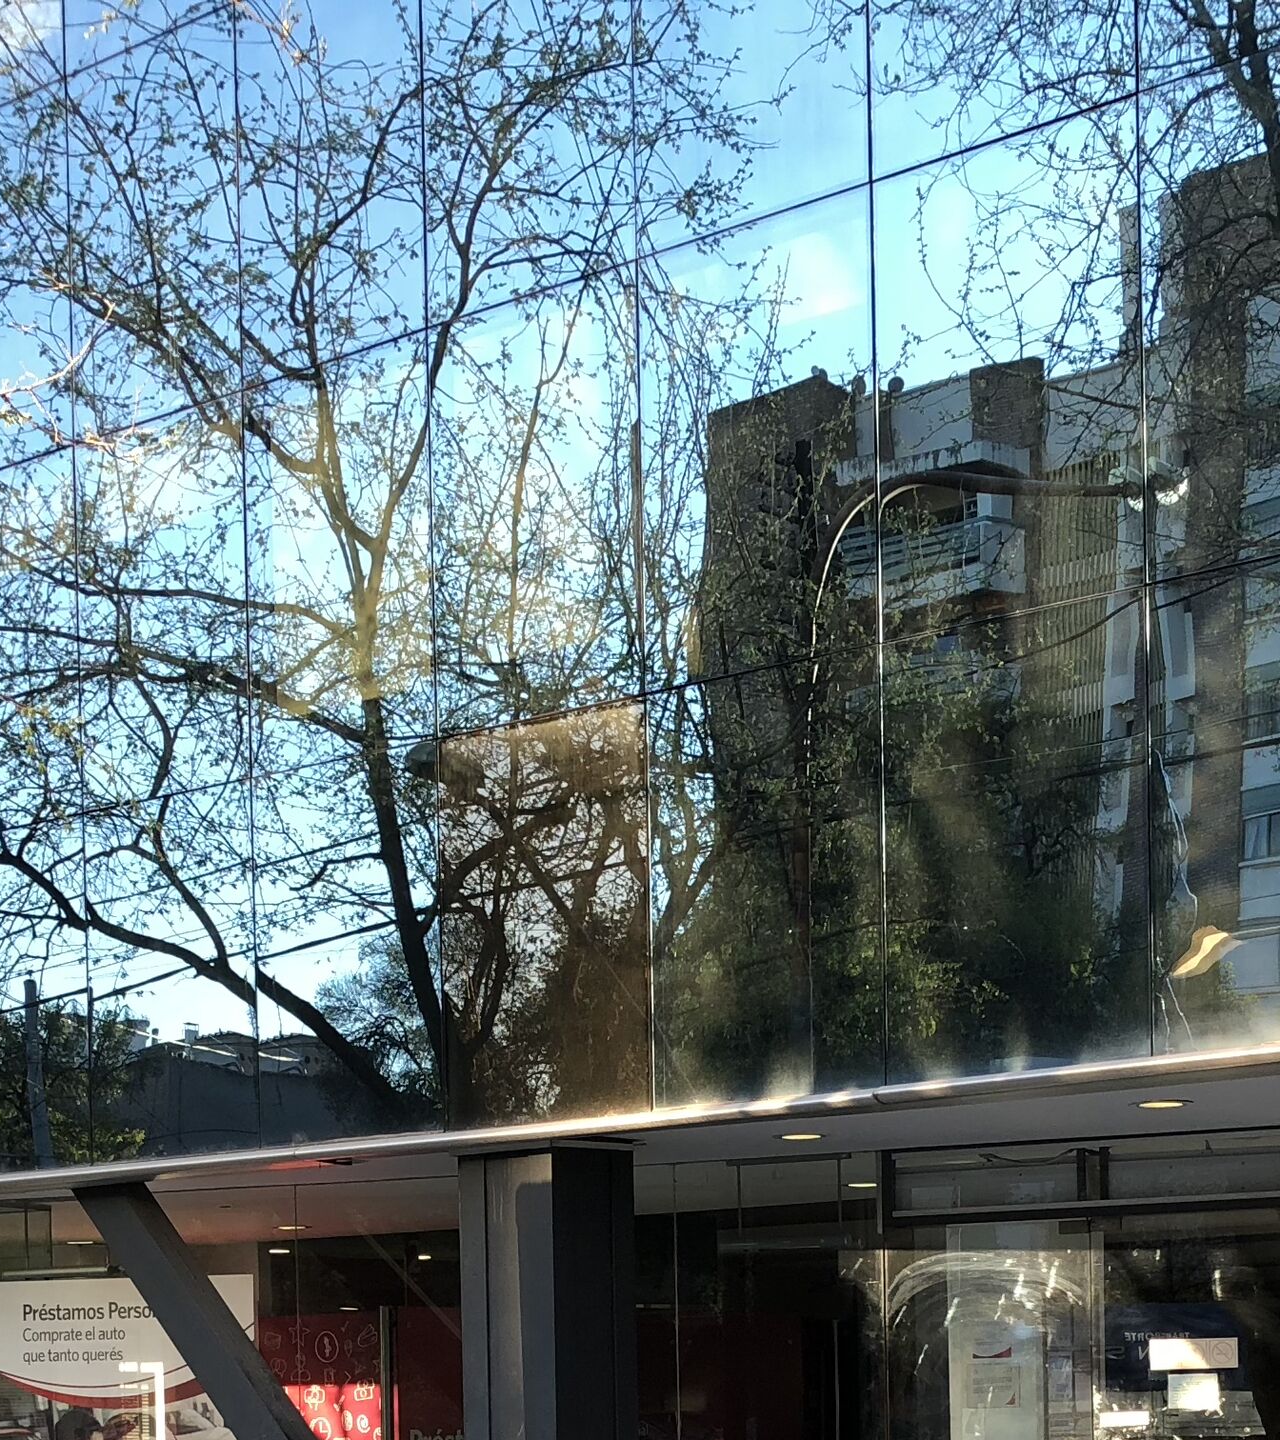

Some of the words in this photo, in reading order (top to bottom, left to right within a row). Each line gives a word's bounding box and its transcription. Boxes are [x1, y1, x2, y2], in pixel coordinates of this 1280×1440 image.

[23, 1302, 105, 1322] Préstamos
[108, 1301, 156, 1319] Perso
[23, 1327, 83, 1347] Comprate
[85, 1326, 96, 1342] el
[98, 1327, 126, 1341] auto
[23, 1349, 45, 1366] que
[46, 1348, 79, 1363] tanto
[81, 1346, 123, 1365] querés
